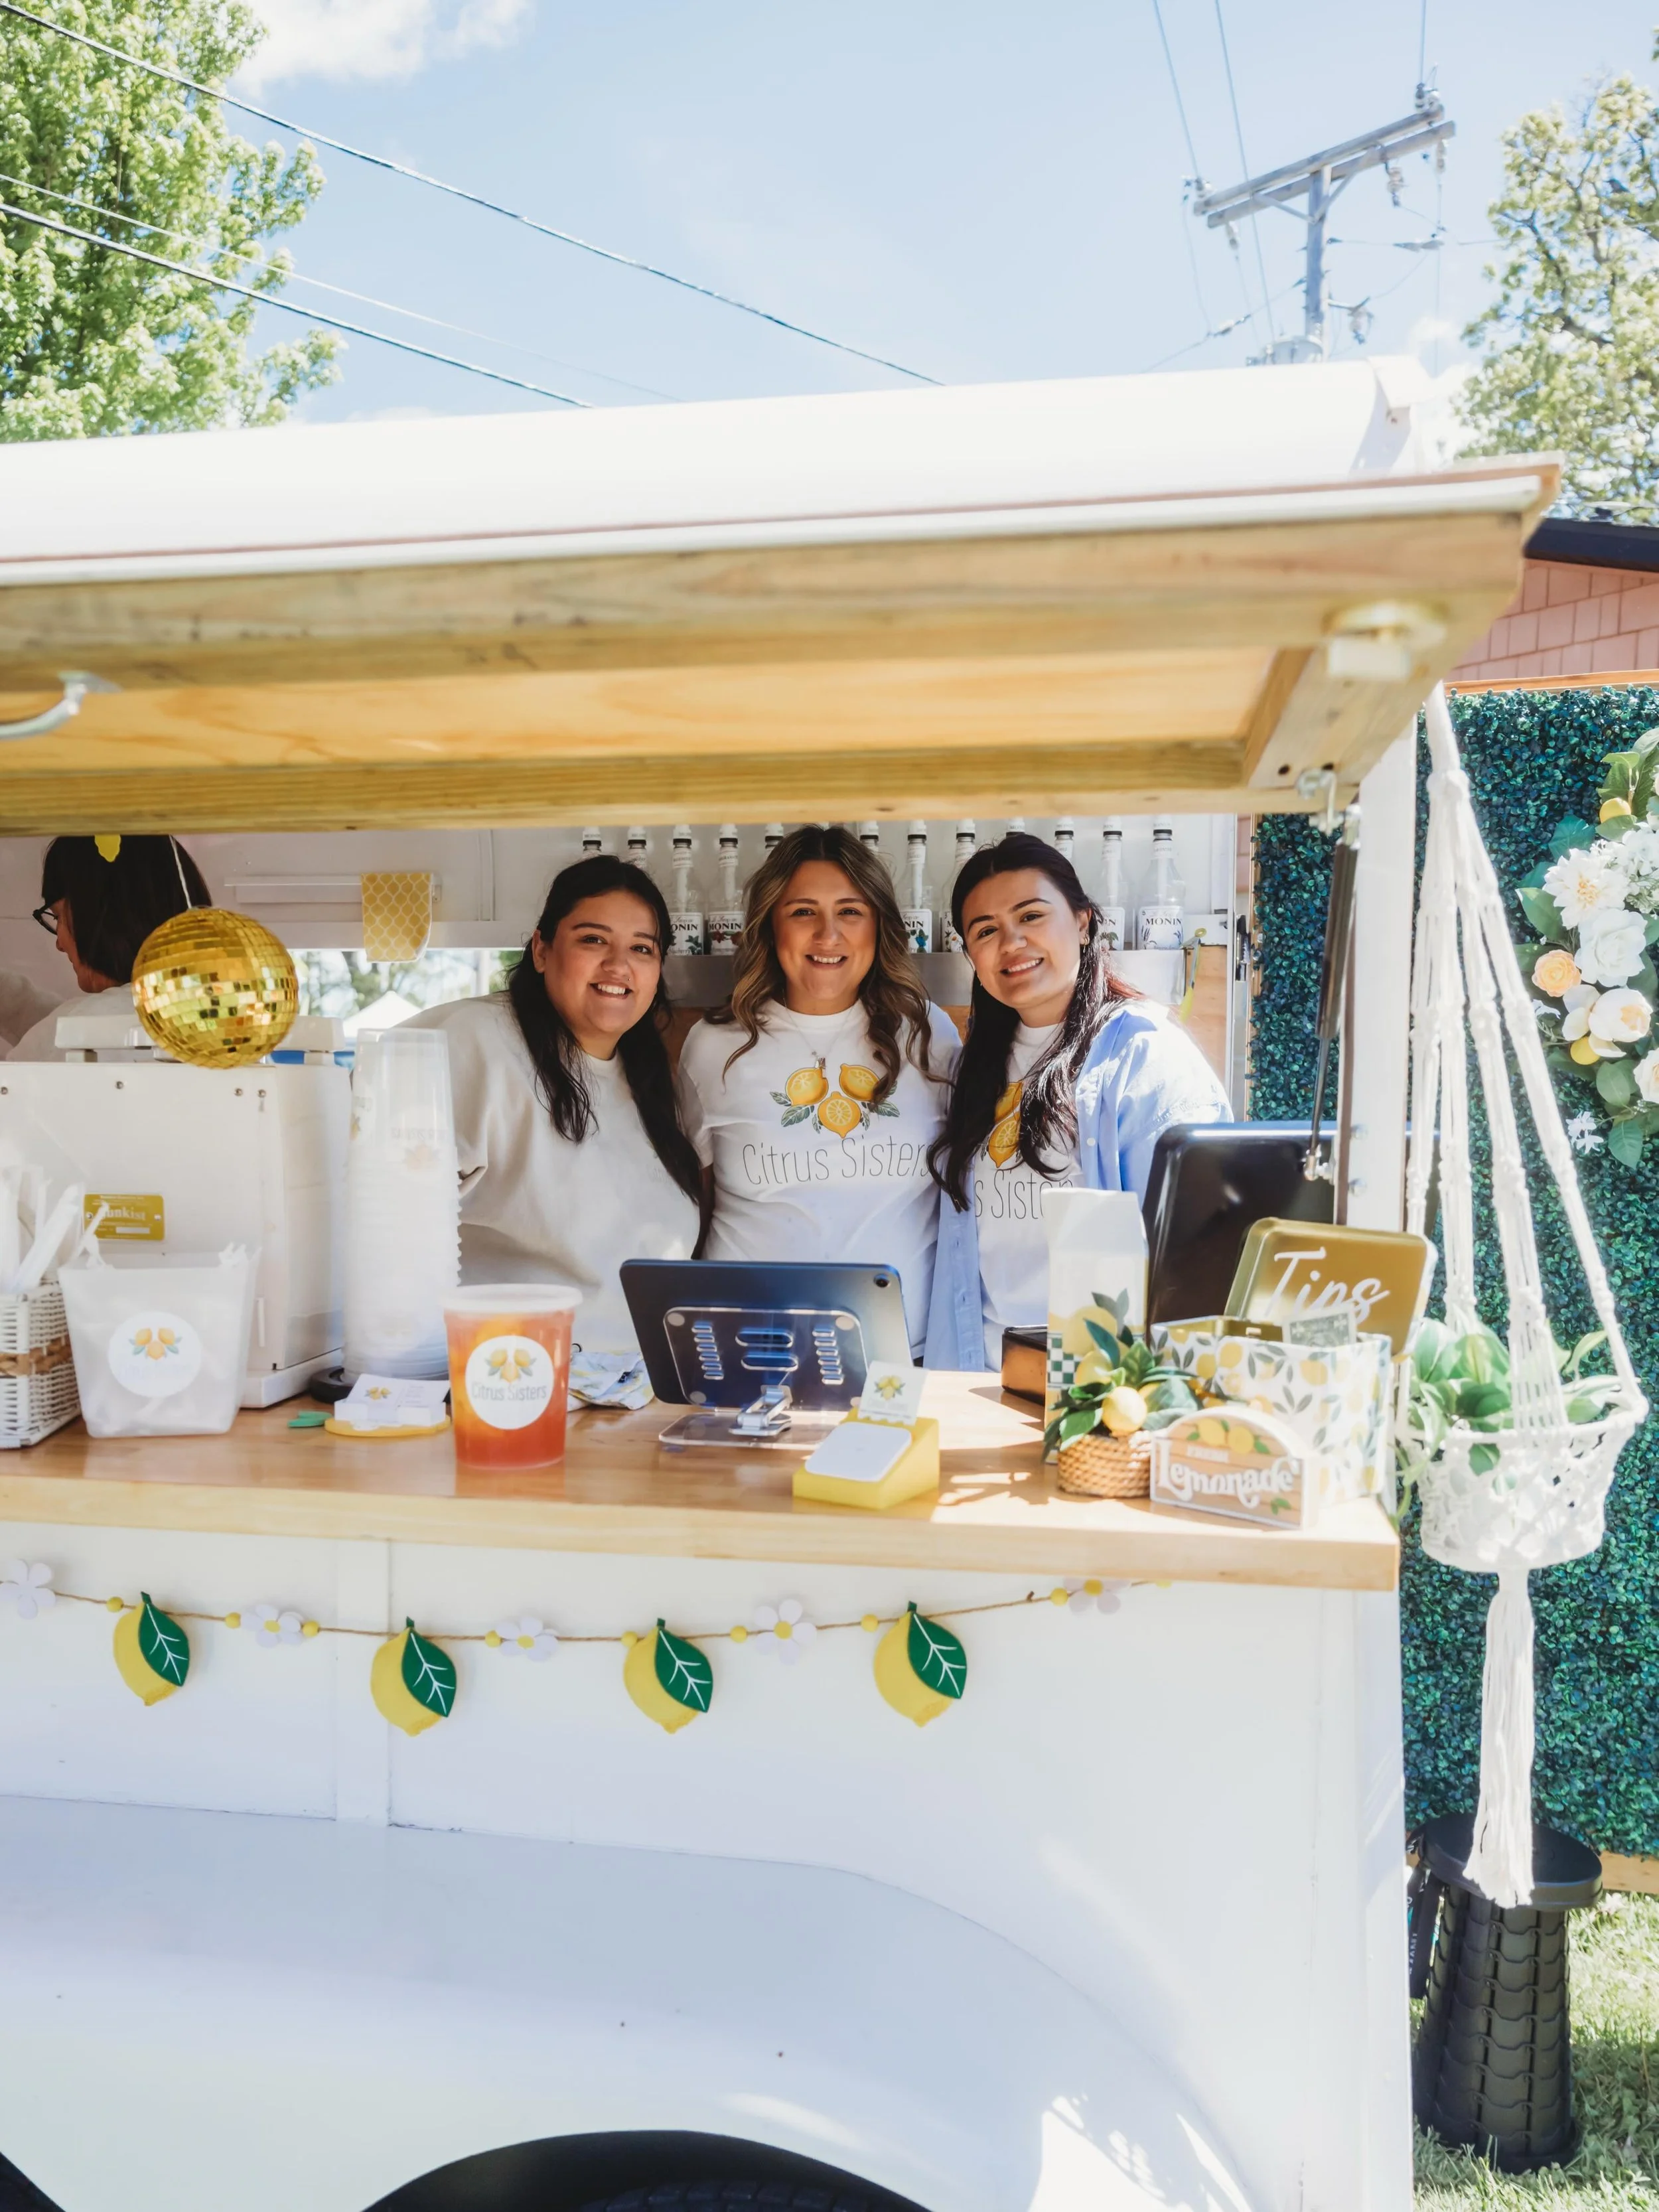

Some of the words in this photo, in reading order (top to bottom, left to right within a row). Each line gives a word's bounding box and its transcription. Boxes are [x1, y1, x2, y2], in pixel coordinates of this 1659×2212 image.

[743, 1142, 830, 1185] Citrus
[105, 1206, 146, 1221] unkist
[1264, 1246, 1390, 1325] Tips
[471, 1381, 504, 1402] Citrus
[507, 1382, 547, 1402] Sisters
[1156, 1439, 1300, 1509] Lemonade
